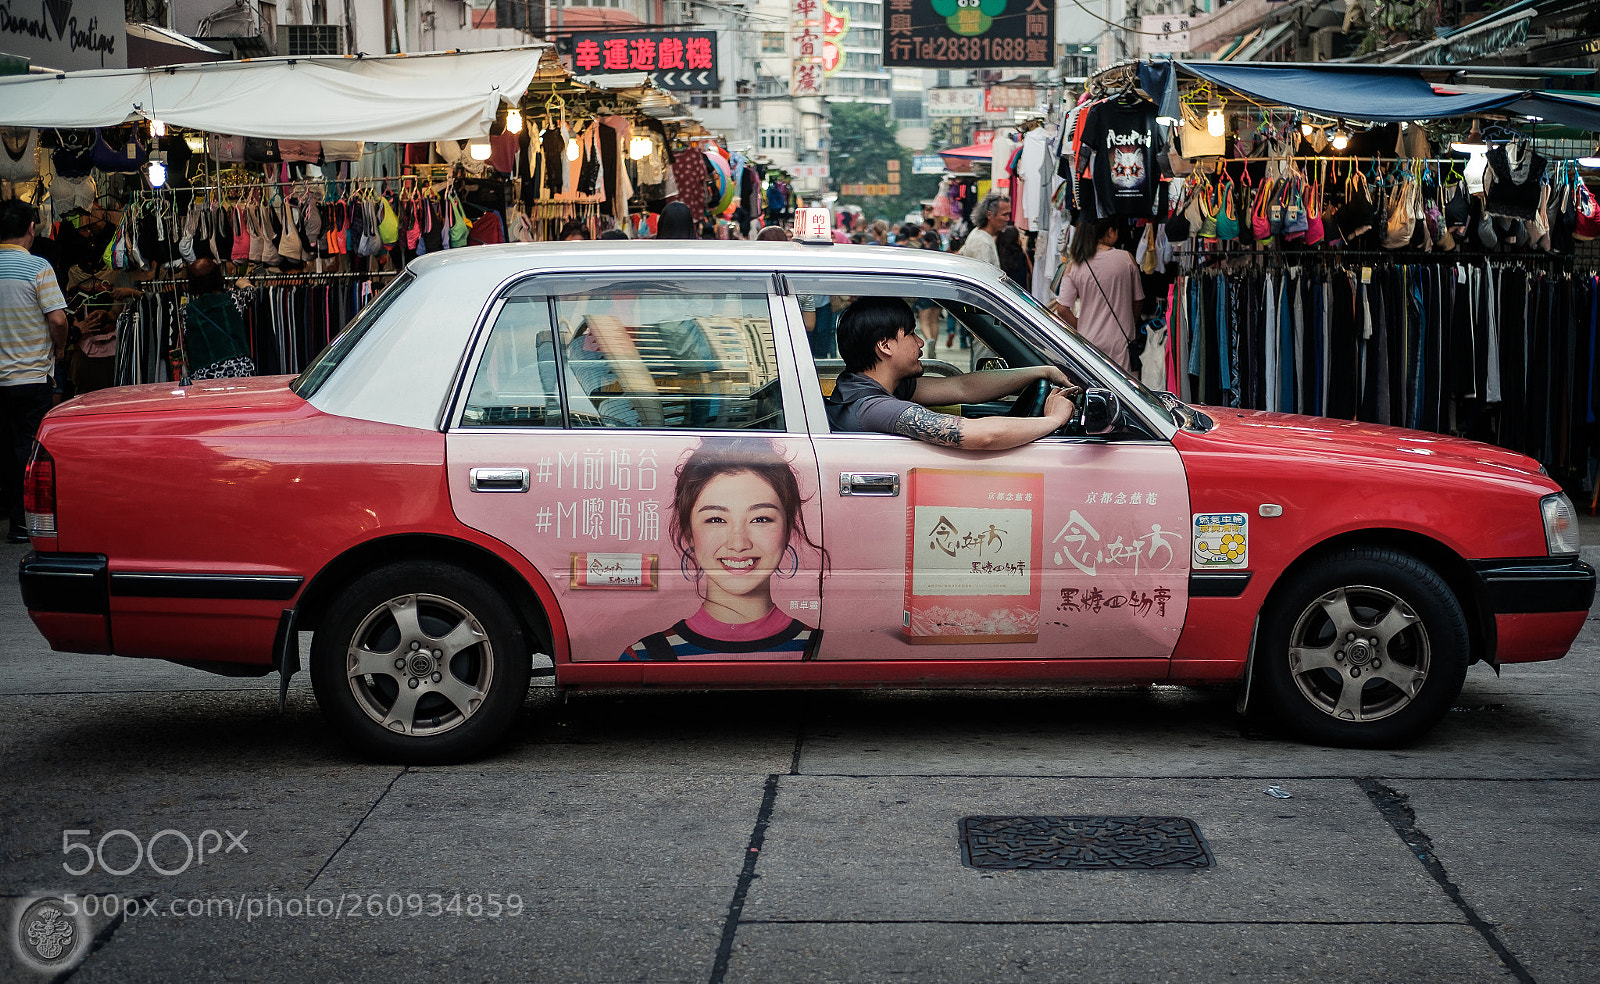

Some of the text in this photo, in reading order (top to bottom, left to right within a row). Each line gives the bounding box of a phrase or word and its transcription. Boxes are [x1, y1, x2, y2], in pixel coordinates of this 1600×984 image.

[69, 16, 115, 67] Boutique
[575, 37, 713, 71] 幸運遊戲機
[812, 214, 826, 235] 的士
[536, 448, 659, 491] #M前唔谷
[535, 497, 660, 541] #M嚟唔痛
[1056, 586, 1172, 618] 黑糖四物膏
